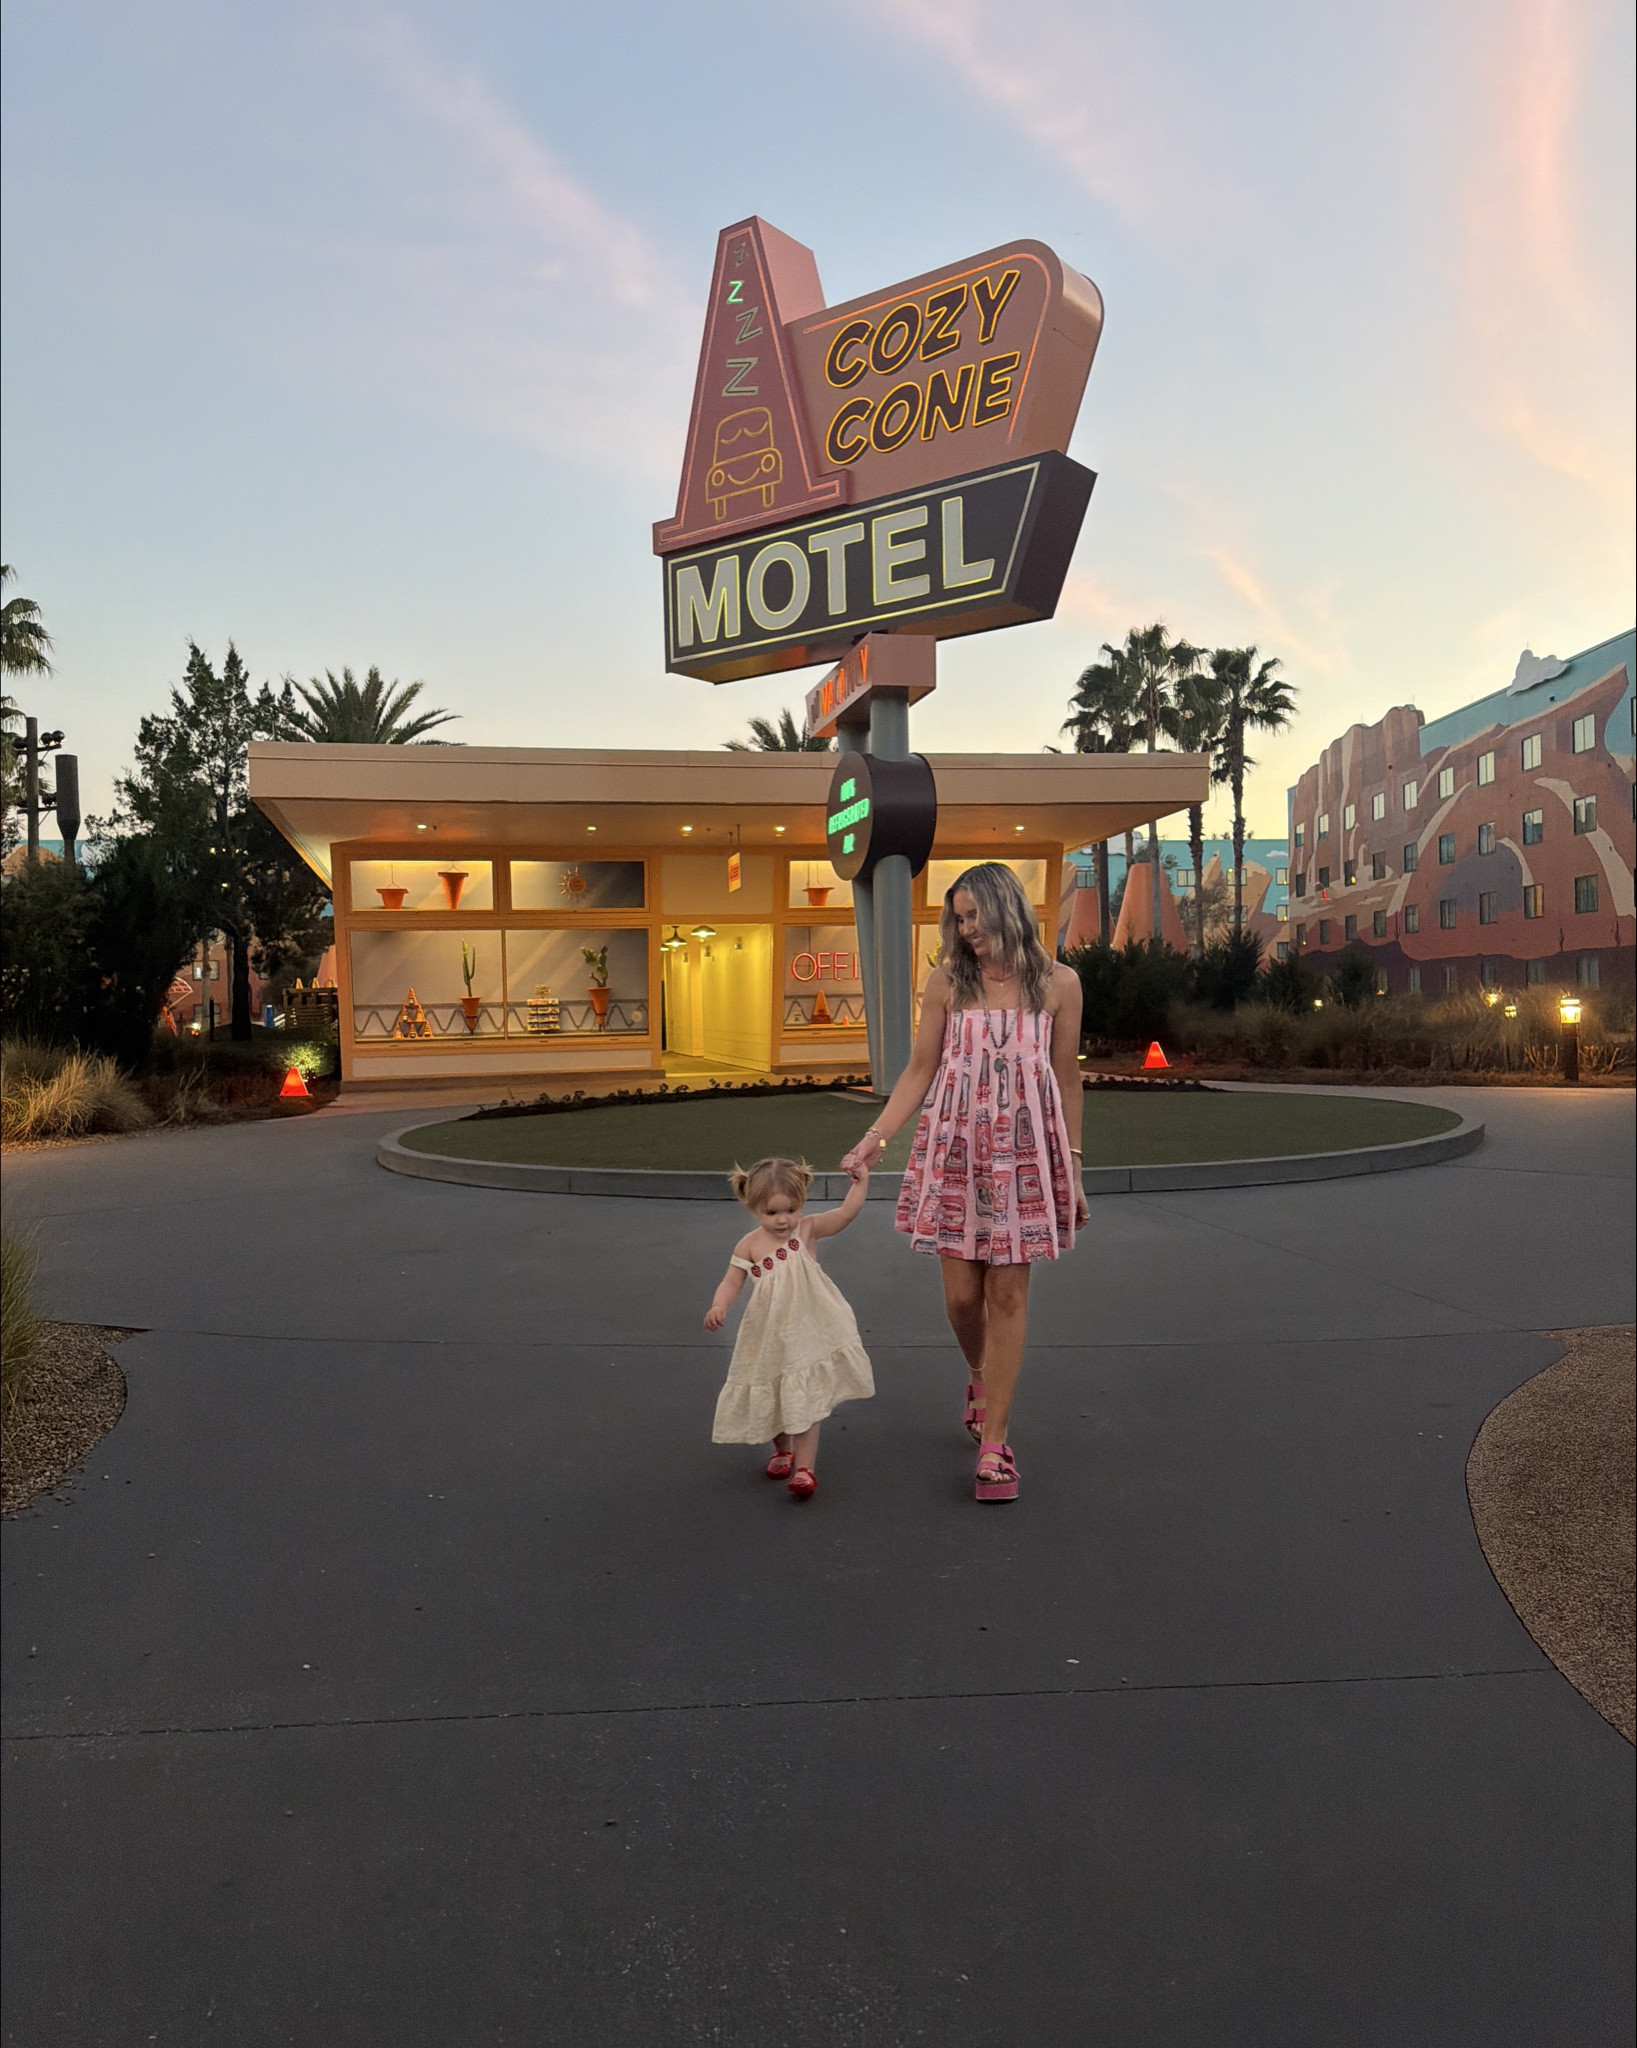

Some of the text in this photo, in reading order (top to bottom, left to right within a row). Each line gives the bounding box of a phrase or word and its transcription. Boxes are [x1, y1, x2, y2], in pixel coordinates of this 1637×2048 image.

[825, 269, 1020, 388] COZY
[825, 351, 1020, 465] CONE
[676, 496, 996, 649] MOTEL
[791, 952, 858, 982] OFFI
